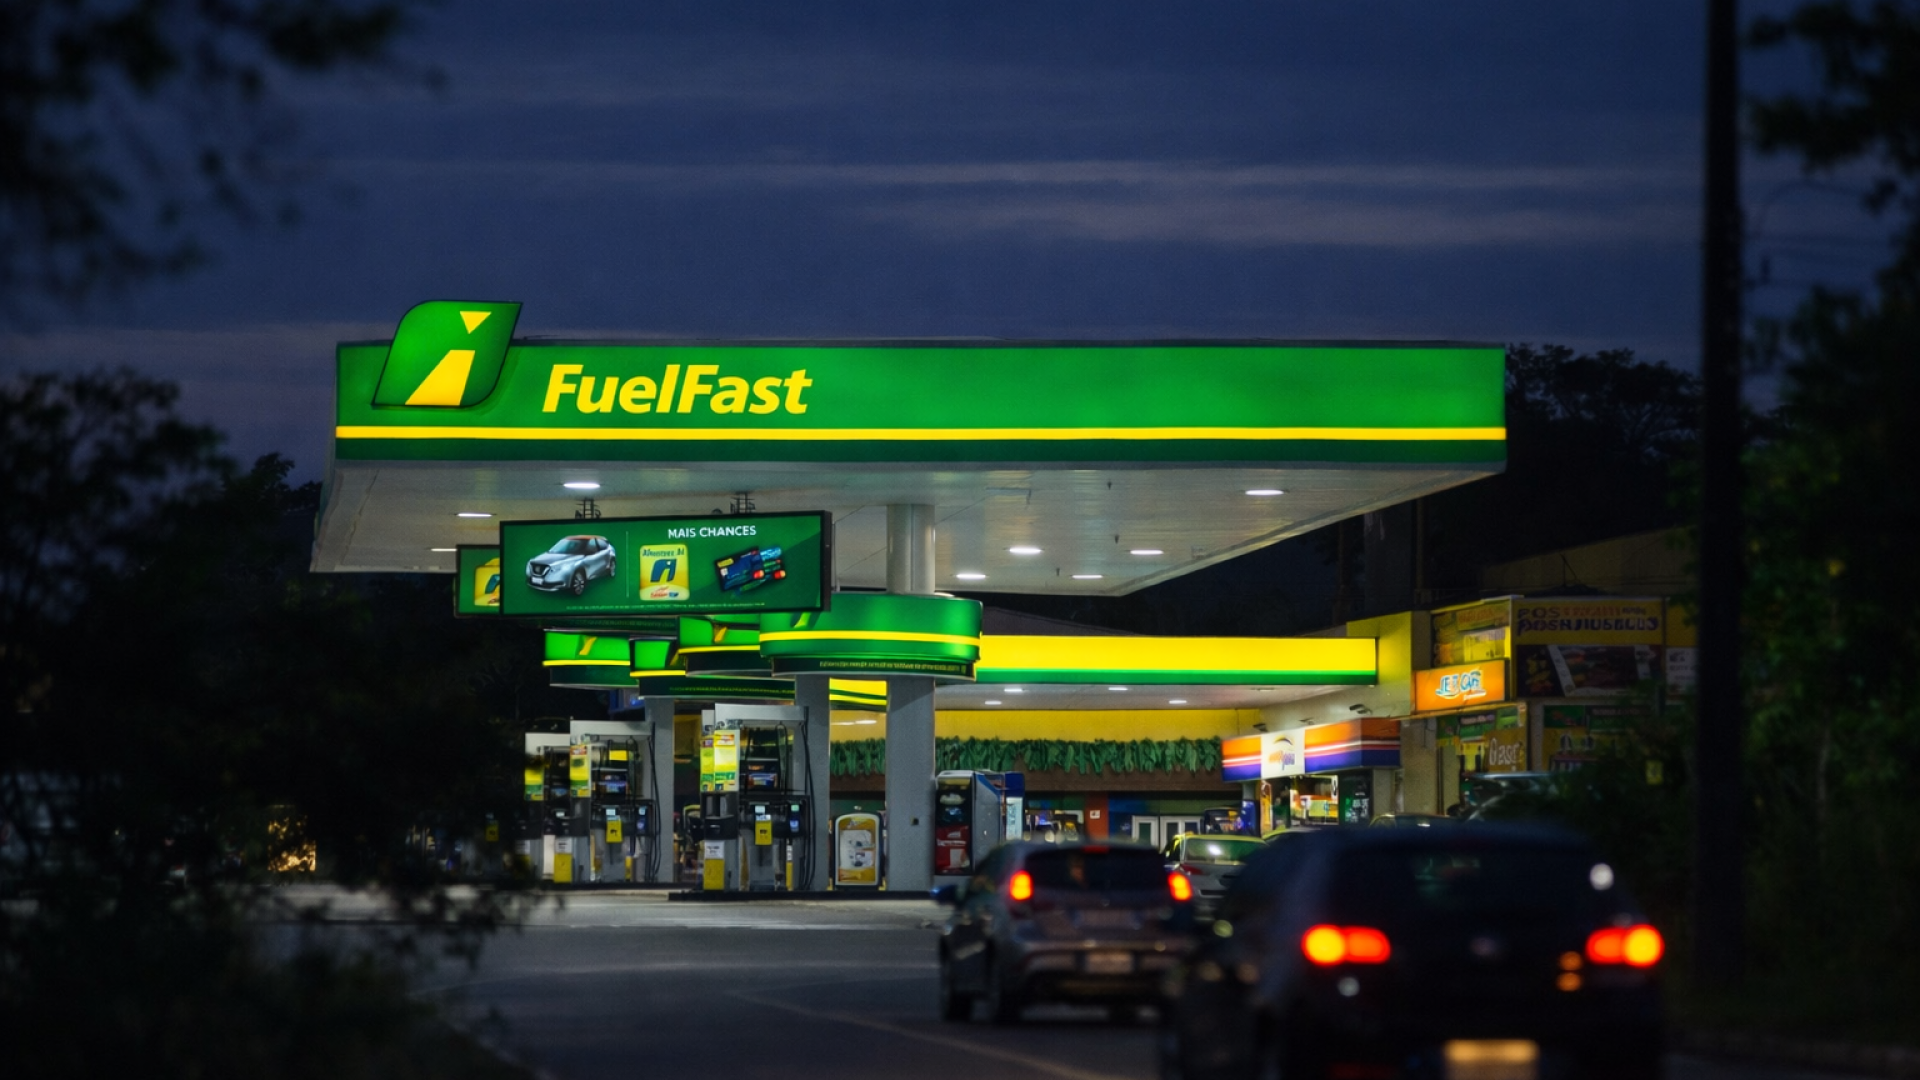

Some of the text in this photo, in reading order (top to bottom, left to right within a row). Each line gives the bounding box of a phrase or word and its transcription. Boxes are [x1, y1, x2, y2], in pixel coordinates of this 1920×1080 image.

[542, 364, 813, 414] FuelFast
[668, 525, 757, 539] MAIS CHANCES
